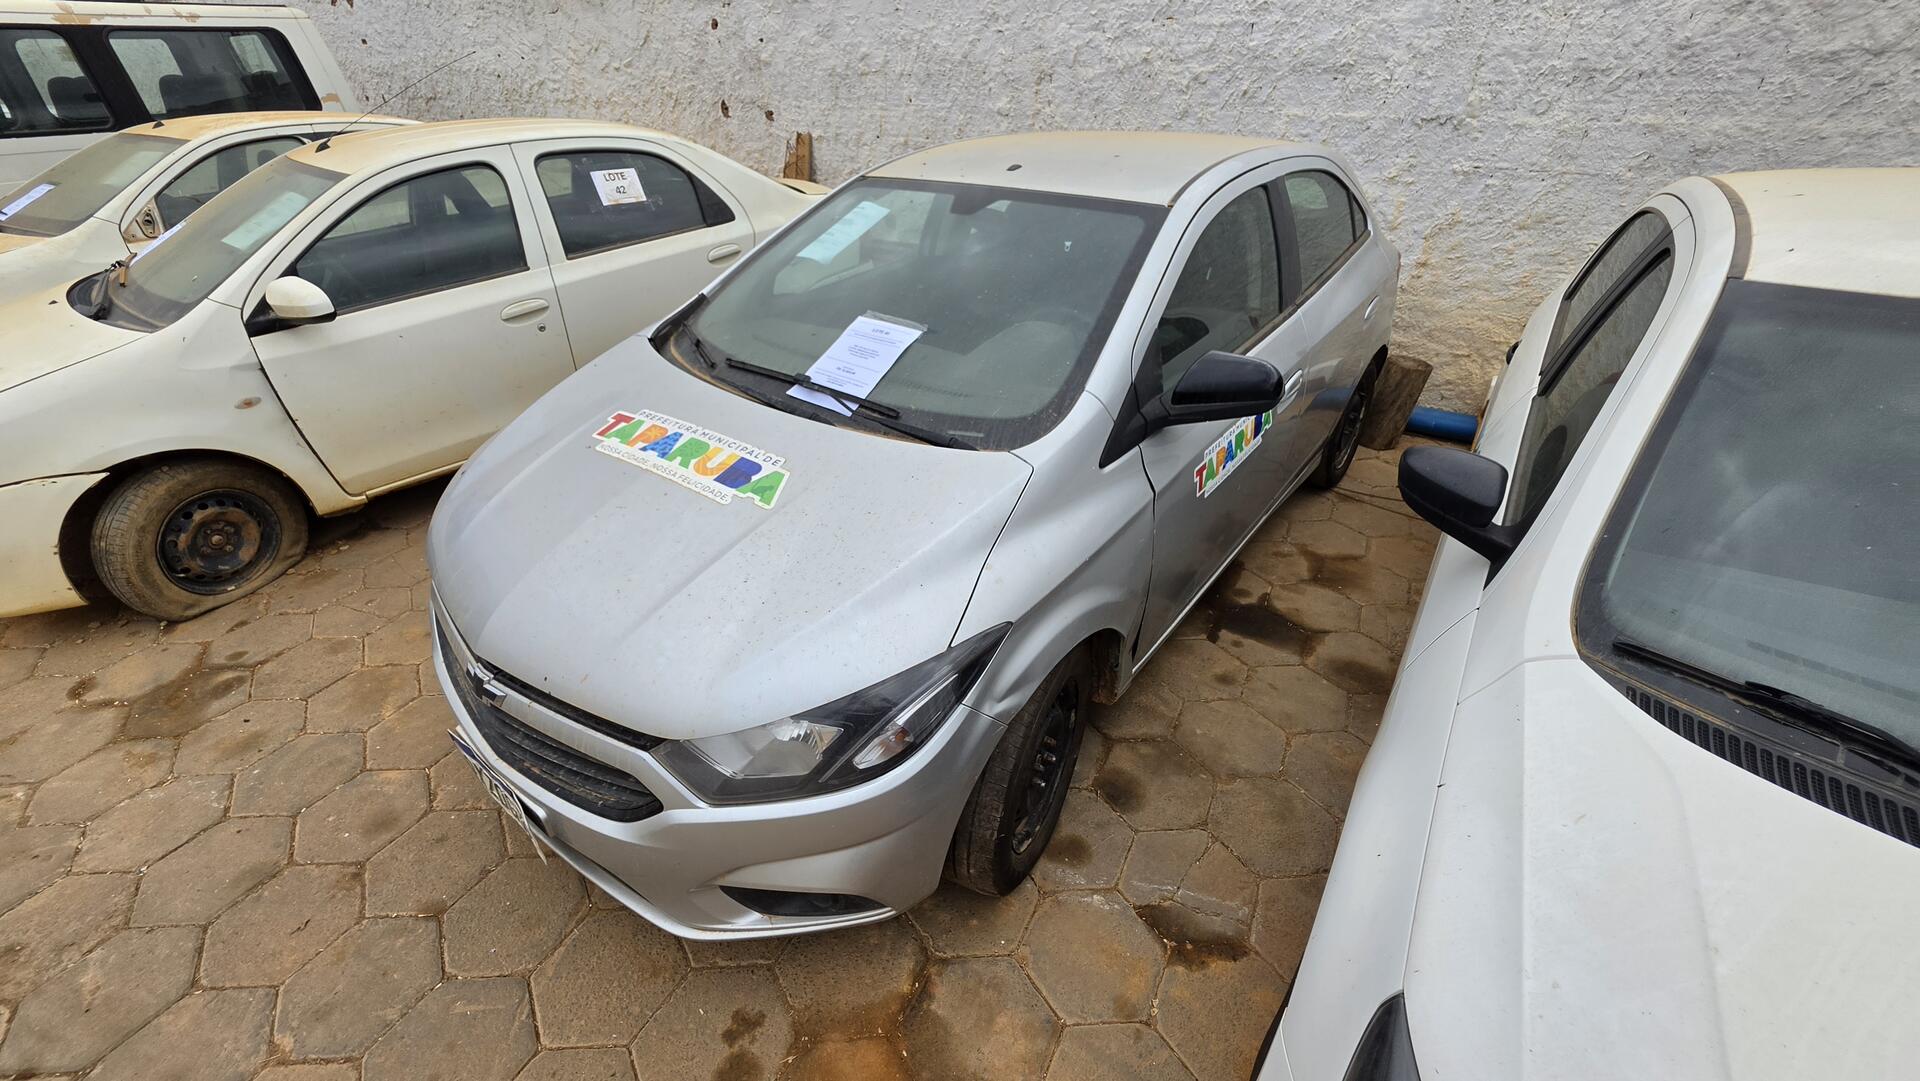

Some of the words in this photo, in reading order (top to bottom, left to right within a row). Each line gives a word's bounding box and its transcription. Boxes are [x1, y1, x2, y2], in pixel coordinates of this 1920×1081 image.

[603, 171, 627, 182] LOTE
[615, 185, 627, 194] 42
[639, 411, 699, 434] PREFEITURA
[700, 431, 761, 459] MUNICIPAL
[762, 455, 782, 467] DE
[596, 413, 786, 506] TAPARUBA
[652, 461, 679, 478] NOSSA
